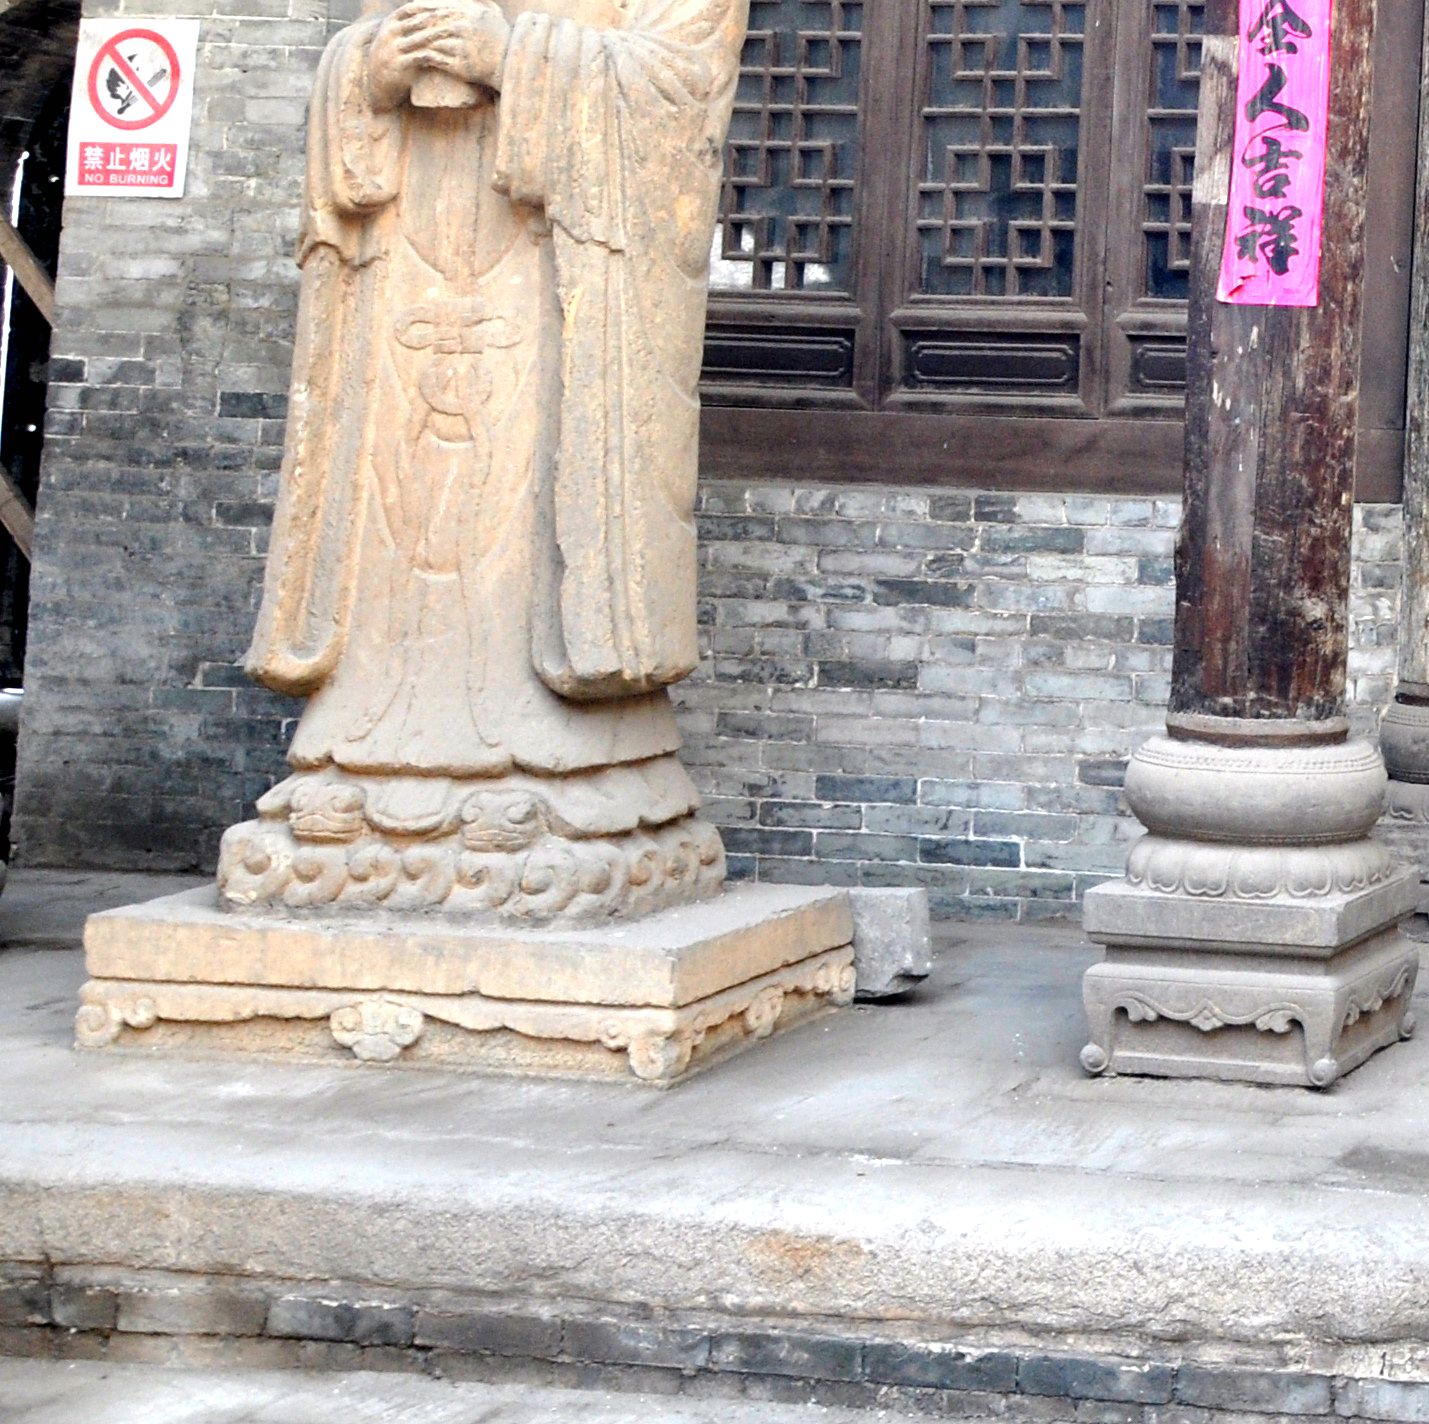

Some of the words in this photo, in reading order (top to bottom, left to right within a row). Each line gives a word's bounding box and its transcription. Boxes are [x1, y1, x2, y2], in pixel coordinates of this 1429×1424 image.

[83, 145, 172, 172] 禁止烟火
[84, 173, 104, 184] NO
[109, 173, 169, 185] BURNING
